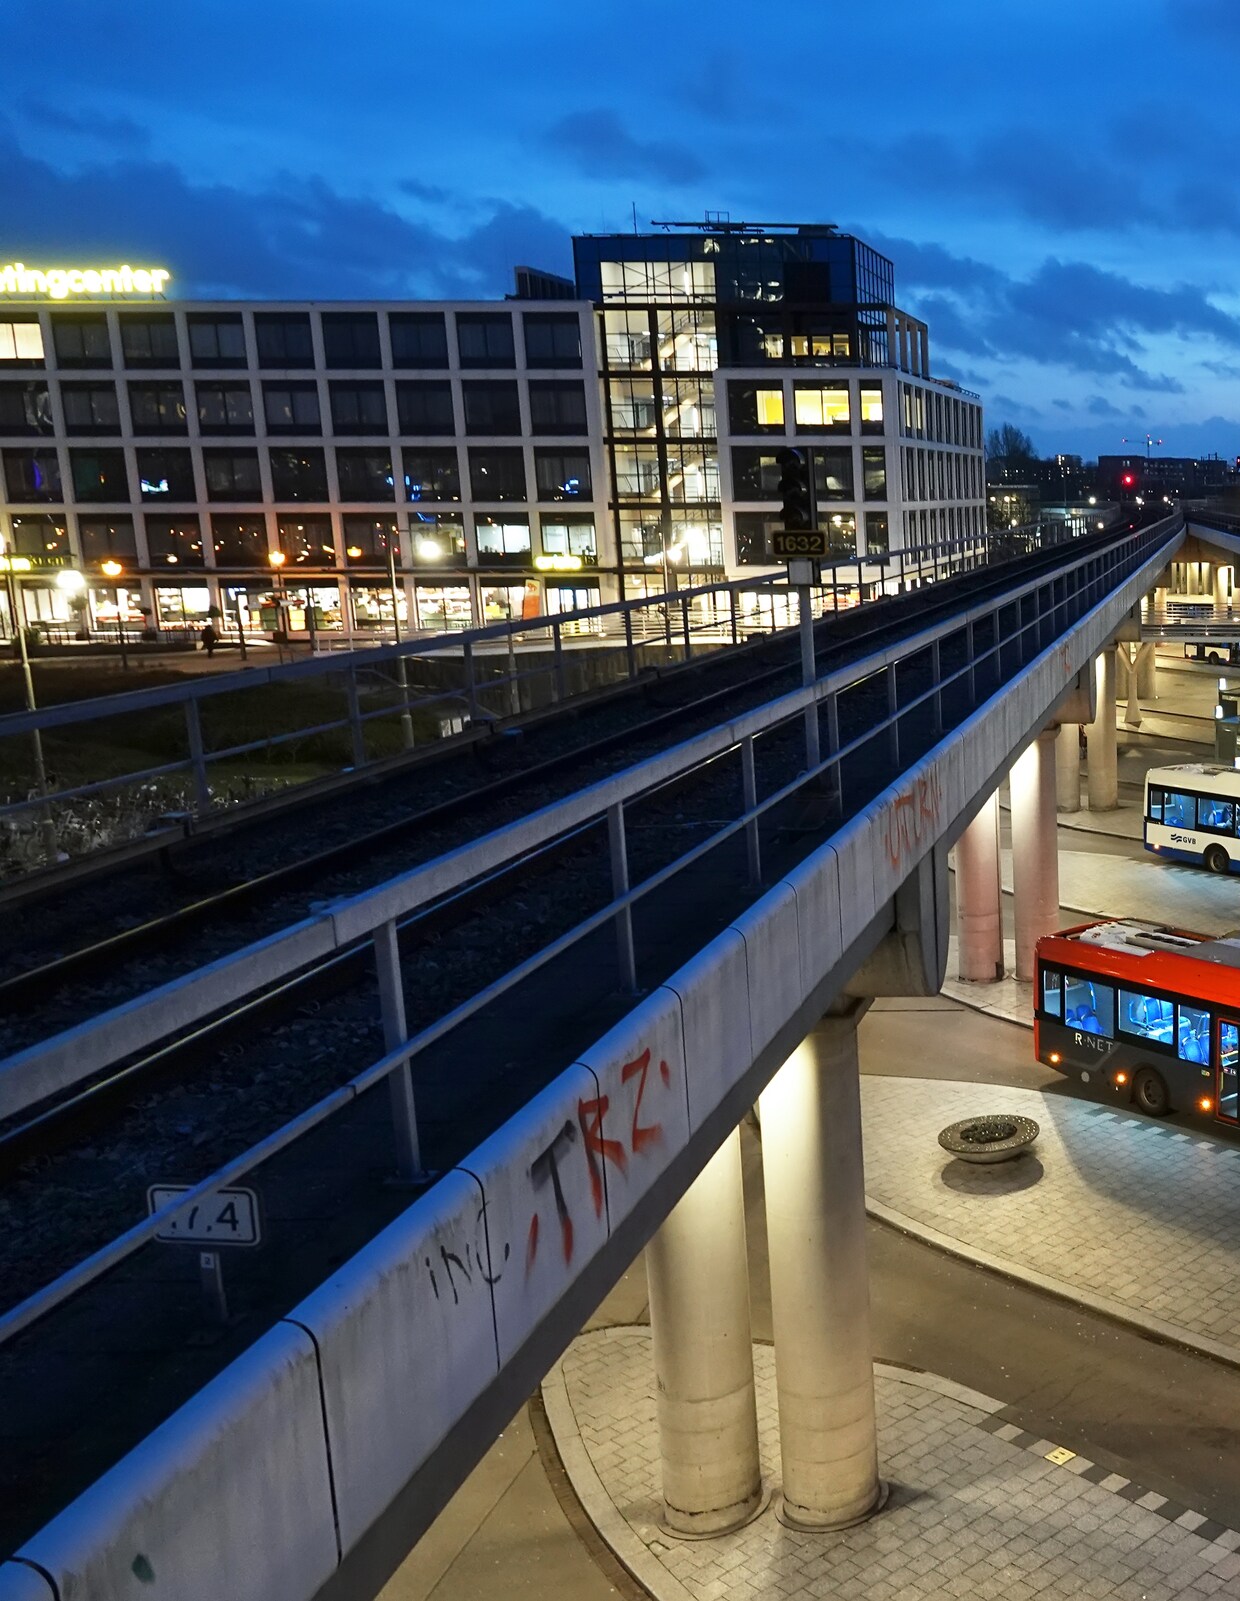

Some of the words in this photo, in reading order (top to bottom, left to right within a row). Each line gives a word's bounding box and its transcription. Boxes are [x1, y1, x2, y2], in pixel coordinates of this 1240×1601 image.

[0, 262, 170, 299] tingcenter
[777, 535, 822, 552] 1632
[1182, 836, 1197, 845] GVB
